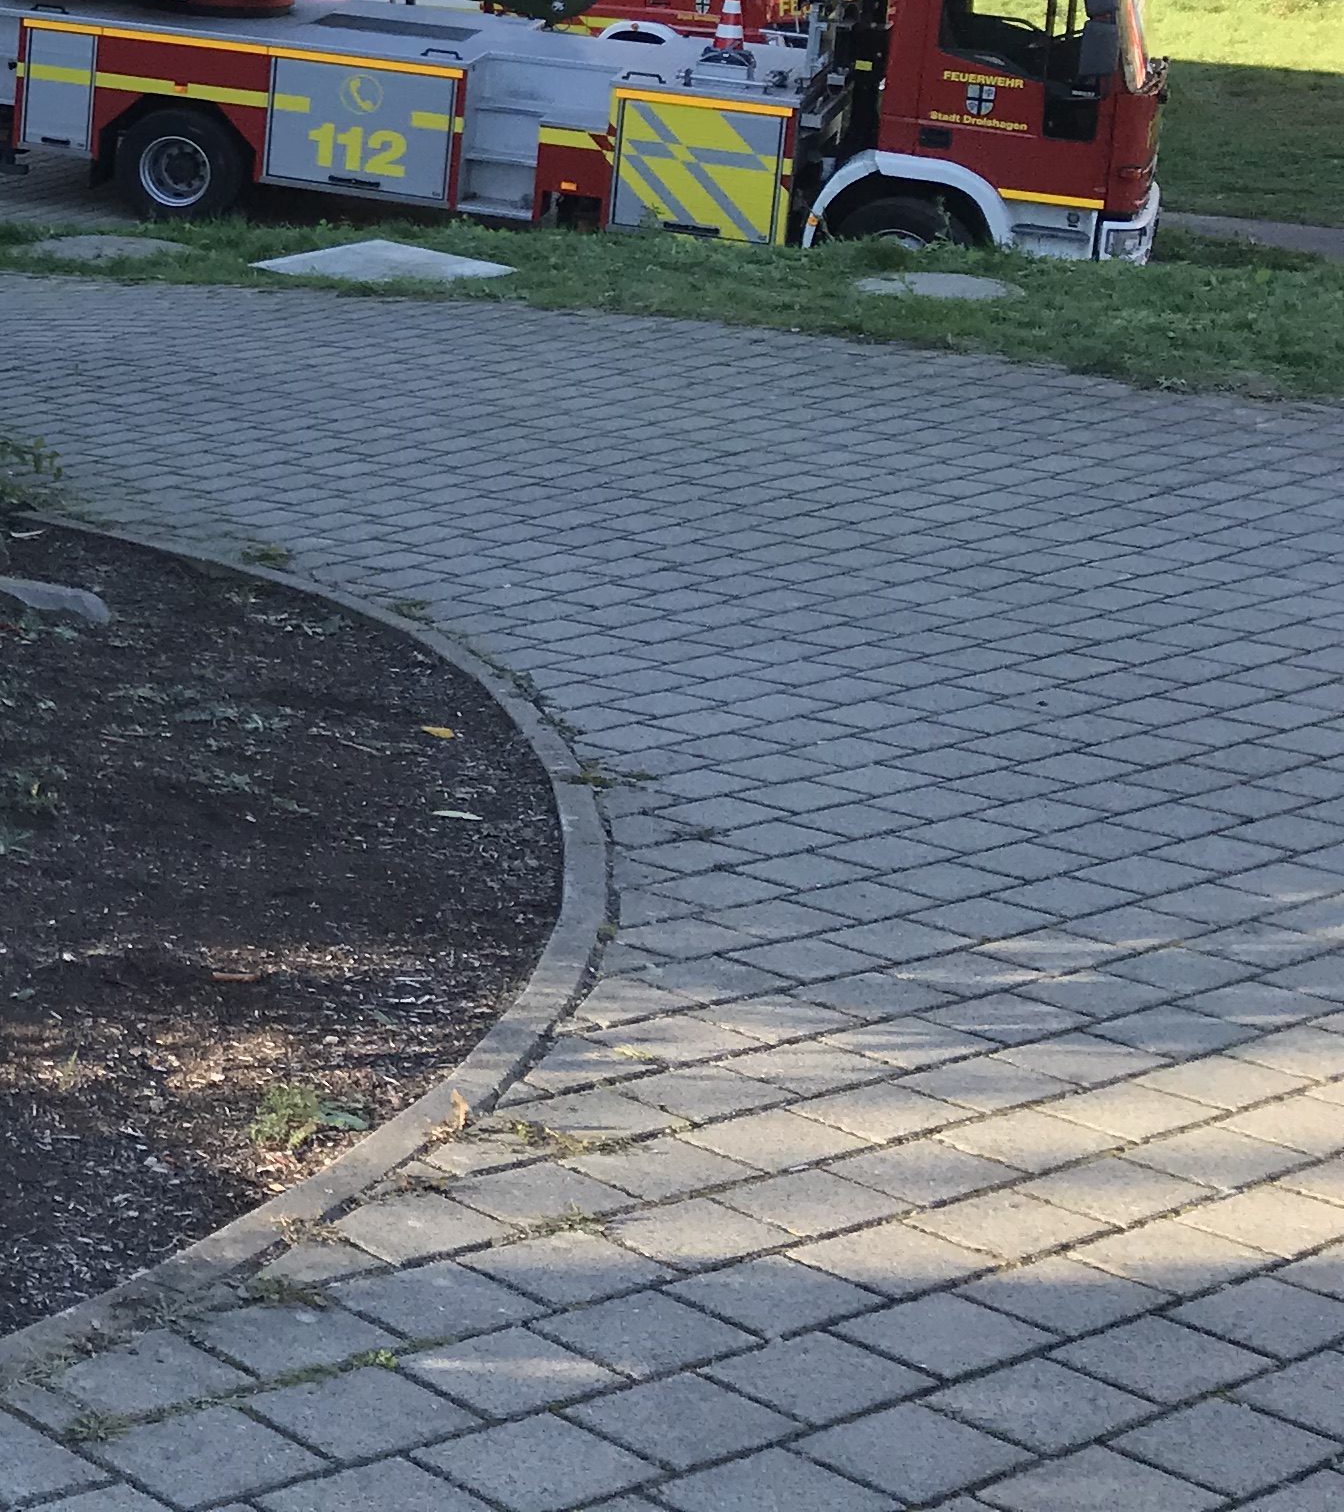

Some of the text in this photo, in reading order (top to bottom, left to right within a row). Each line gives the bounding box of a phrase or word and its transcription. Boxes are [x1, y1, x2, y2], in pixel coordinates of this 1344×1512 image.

[943, 70, 1024, 88] FEUERWEHR
[929, 110, 961, 123] Stadt
[308, 122, 407, 177] 112
